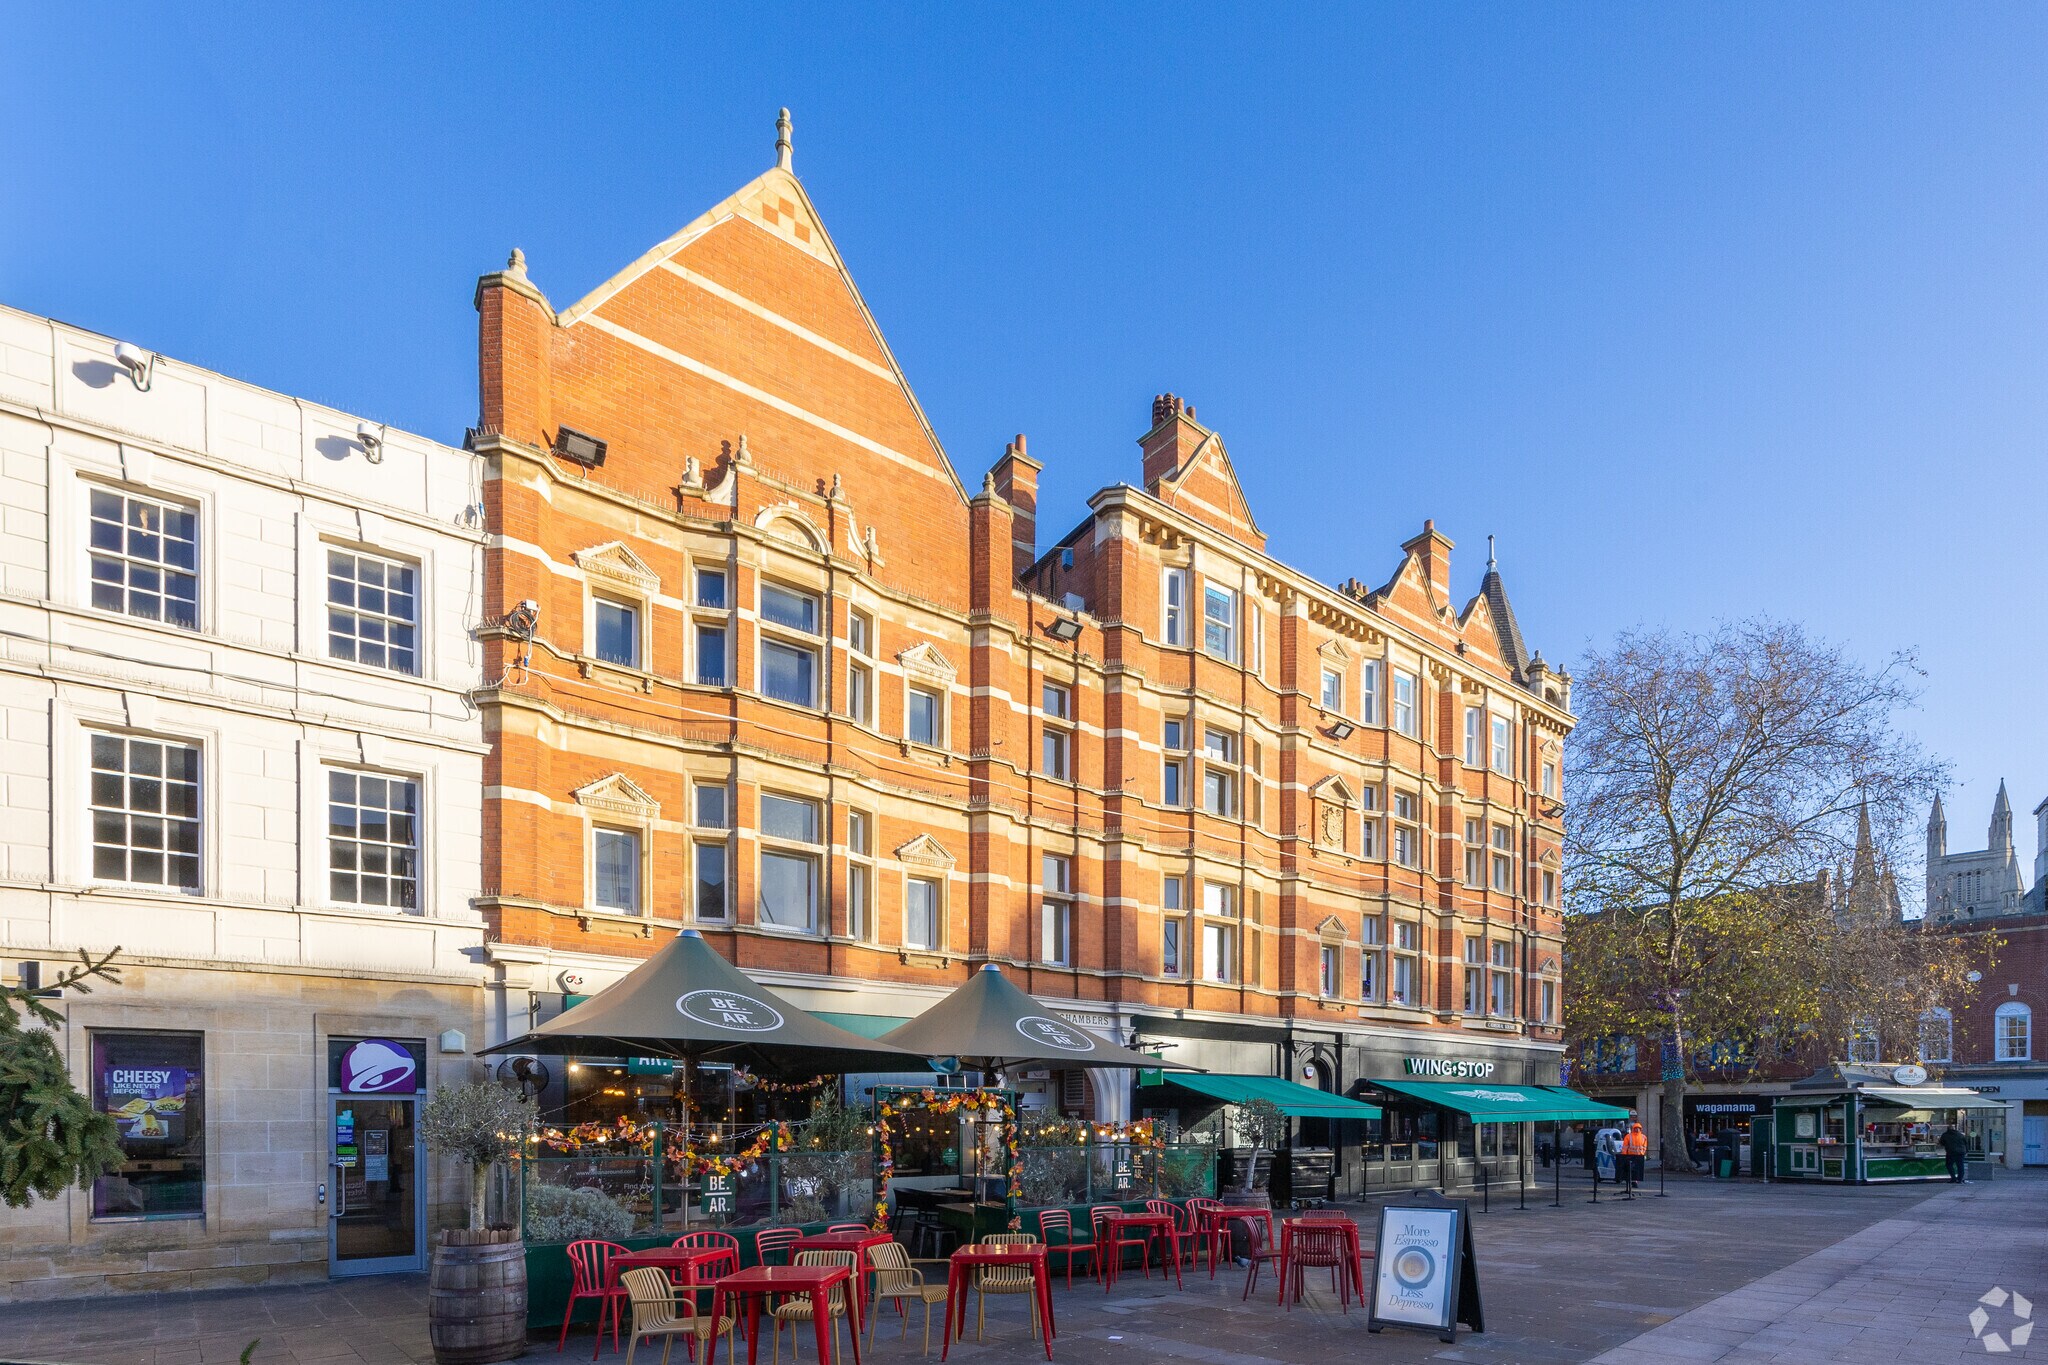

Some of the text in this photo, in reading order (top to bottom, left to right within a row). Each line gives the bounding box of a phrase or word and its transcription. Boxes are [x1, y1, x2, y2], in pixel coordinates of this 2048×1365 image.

[710, 997, 747, 1010] BE.
[722, 1012, 758, 1025] AR.
[1036, 1023, 1064, 1034] BE.
[1052, 1035, 1080, 1046] AR.
[113, 1070, 170, 1084] CHEESY
[1696, 1104, 1755, 1113] wagamama
[1118, 1161, 1130, 1172] BE.
[709, 1175, 730, 1190] BE.
[1118, 1177, 1131, 1189] AR.
[709, 1197, 730, 1212] AR.
[1403, 1224, 1430, 1237] More
[1400, 1287, 1424, 1298] Less
[1388, 1294, 1434, 1311] Depresso
